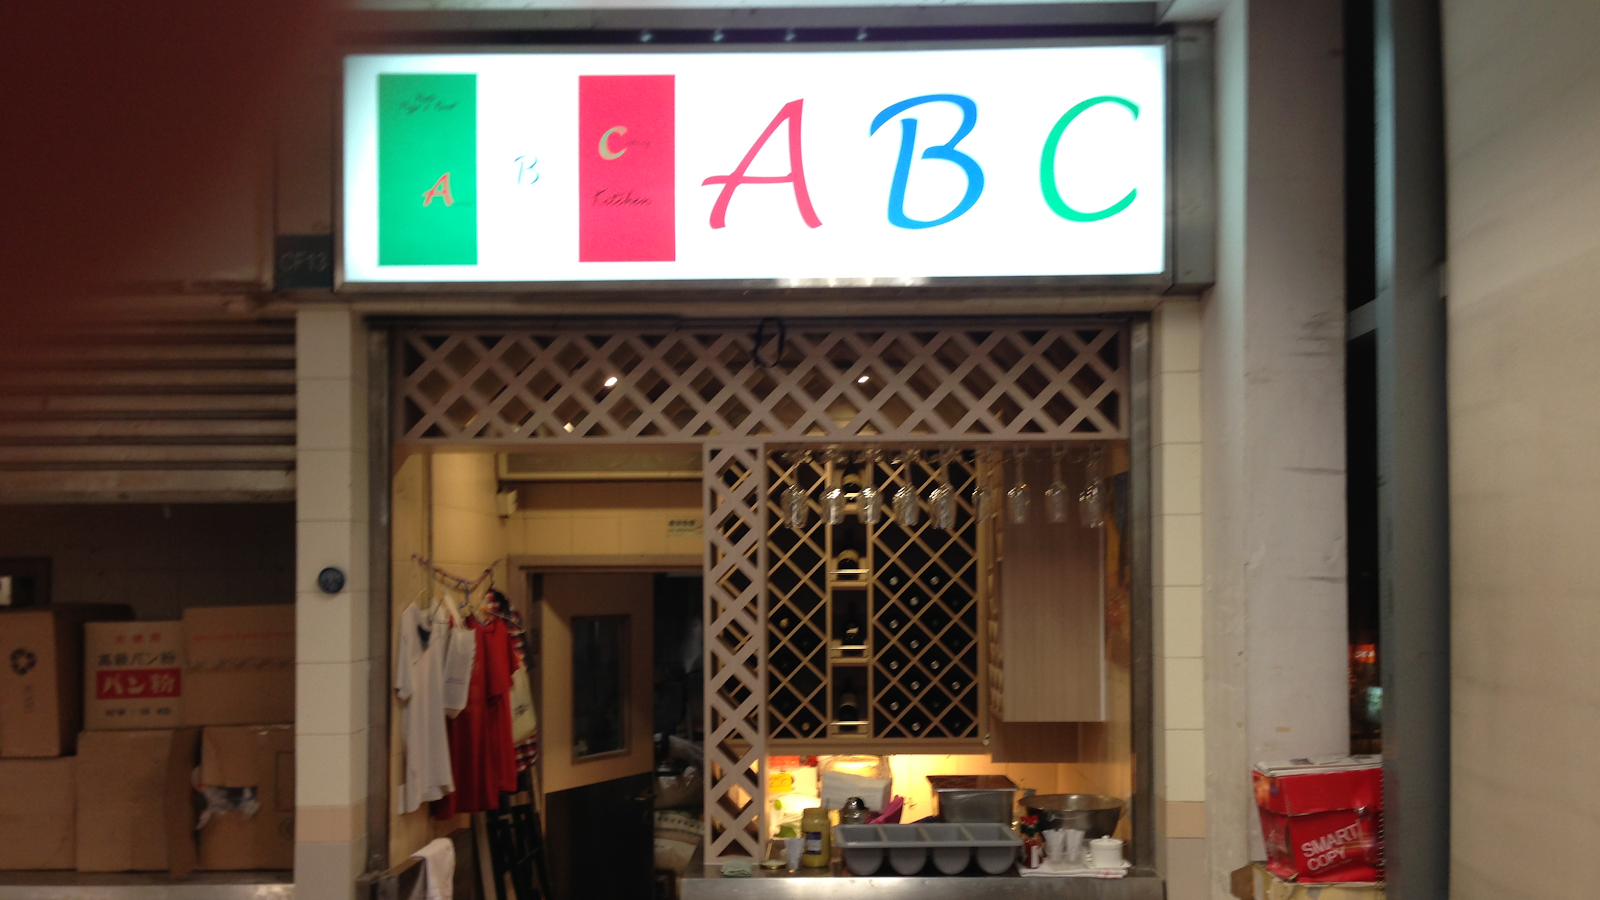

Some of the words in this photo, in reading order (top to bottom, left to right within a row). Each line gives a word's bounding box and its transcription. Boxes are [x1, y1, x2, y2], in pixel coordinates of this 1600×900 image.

[513, 154, 540, 185] B
[103, 673, 176, 695] パン粉
[1301, 821, 1359, 857] SMART
[1307, 847, 1346, 871] COPY
